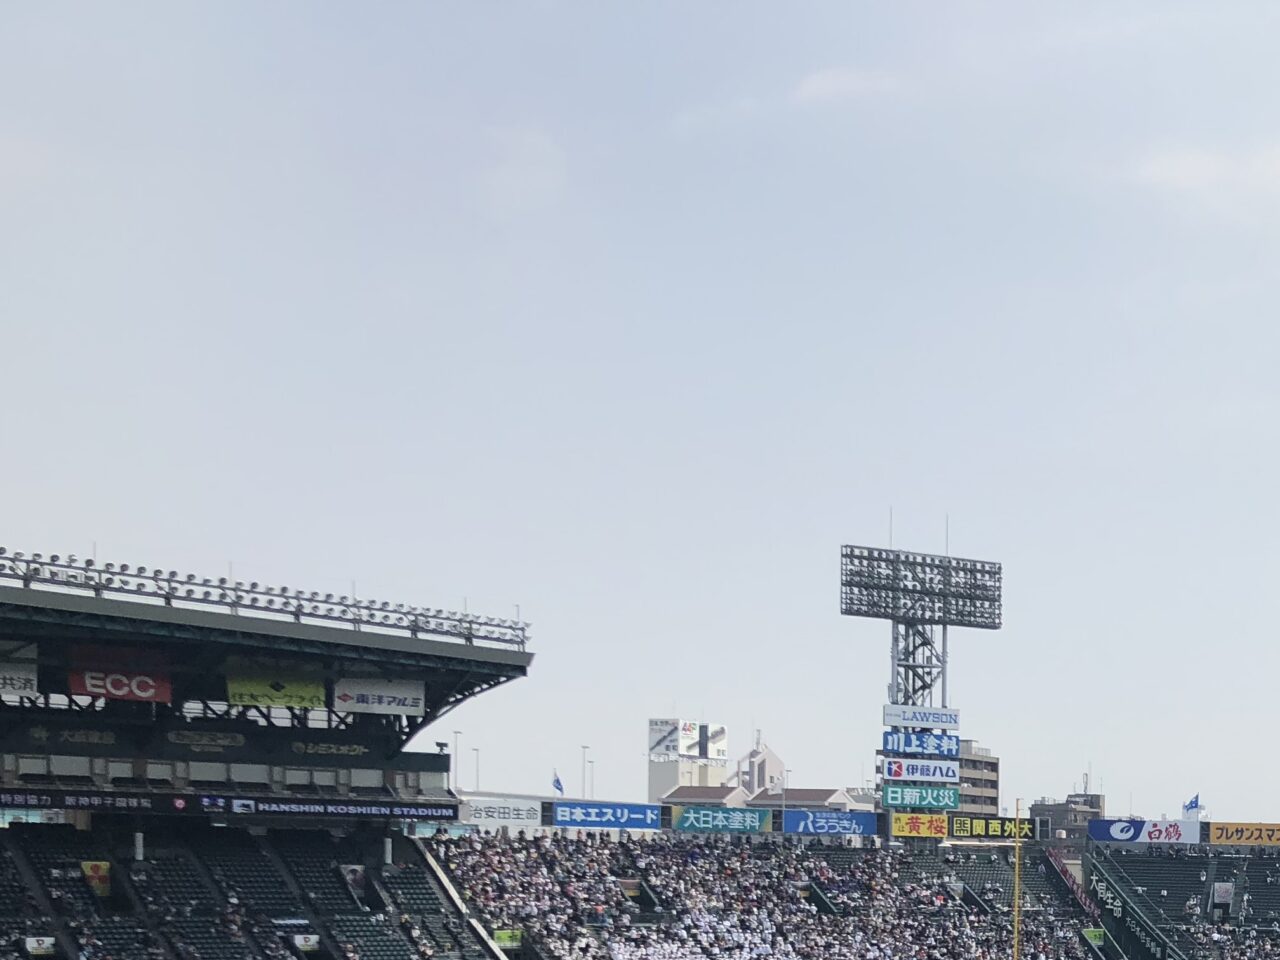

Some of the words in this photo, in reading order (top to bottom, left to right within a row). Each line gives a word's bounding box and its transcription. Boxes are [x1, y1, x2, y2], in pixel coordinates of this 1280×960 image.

[84, 671, 156, 698] ECC
[902, 711, 959, 724] LAWSON
[887, 733, 959, 755] 川上塗料
[906, 764, 957, 778] 伊藤ハム
[887, 787, 955, 806] 日新火災
[258, 803, 324, 813] HANSHIN
[327, 805, 390, 815] KOSHIEN
[392, 807, 454, 817] STADIUM
[557, 807, 659, 824] 日本エスリード
[684, 809, 760, 830] 大日本塗料
[815, 819, 863, 834] ろうきん
[905, 816, 947, 836] 黄桜
[973, 820, 1033, 837] 関西外大
[1148, 823, 1182, 842] 白鶴
